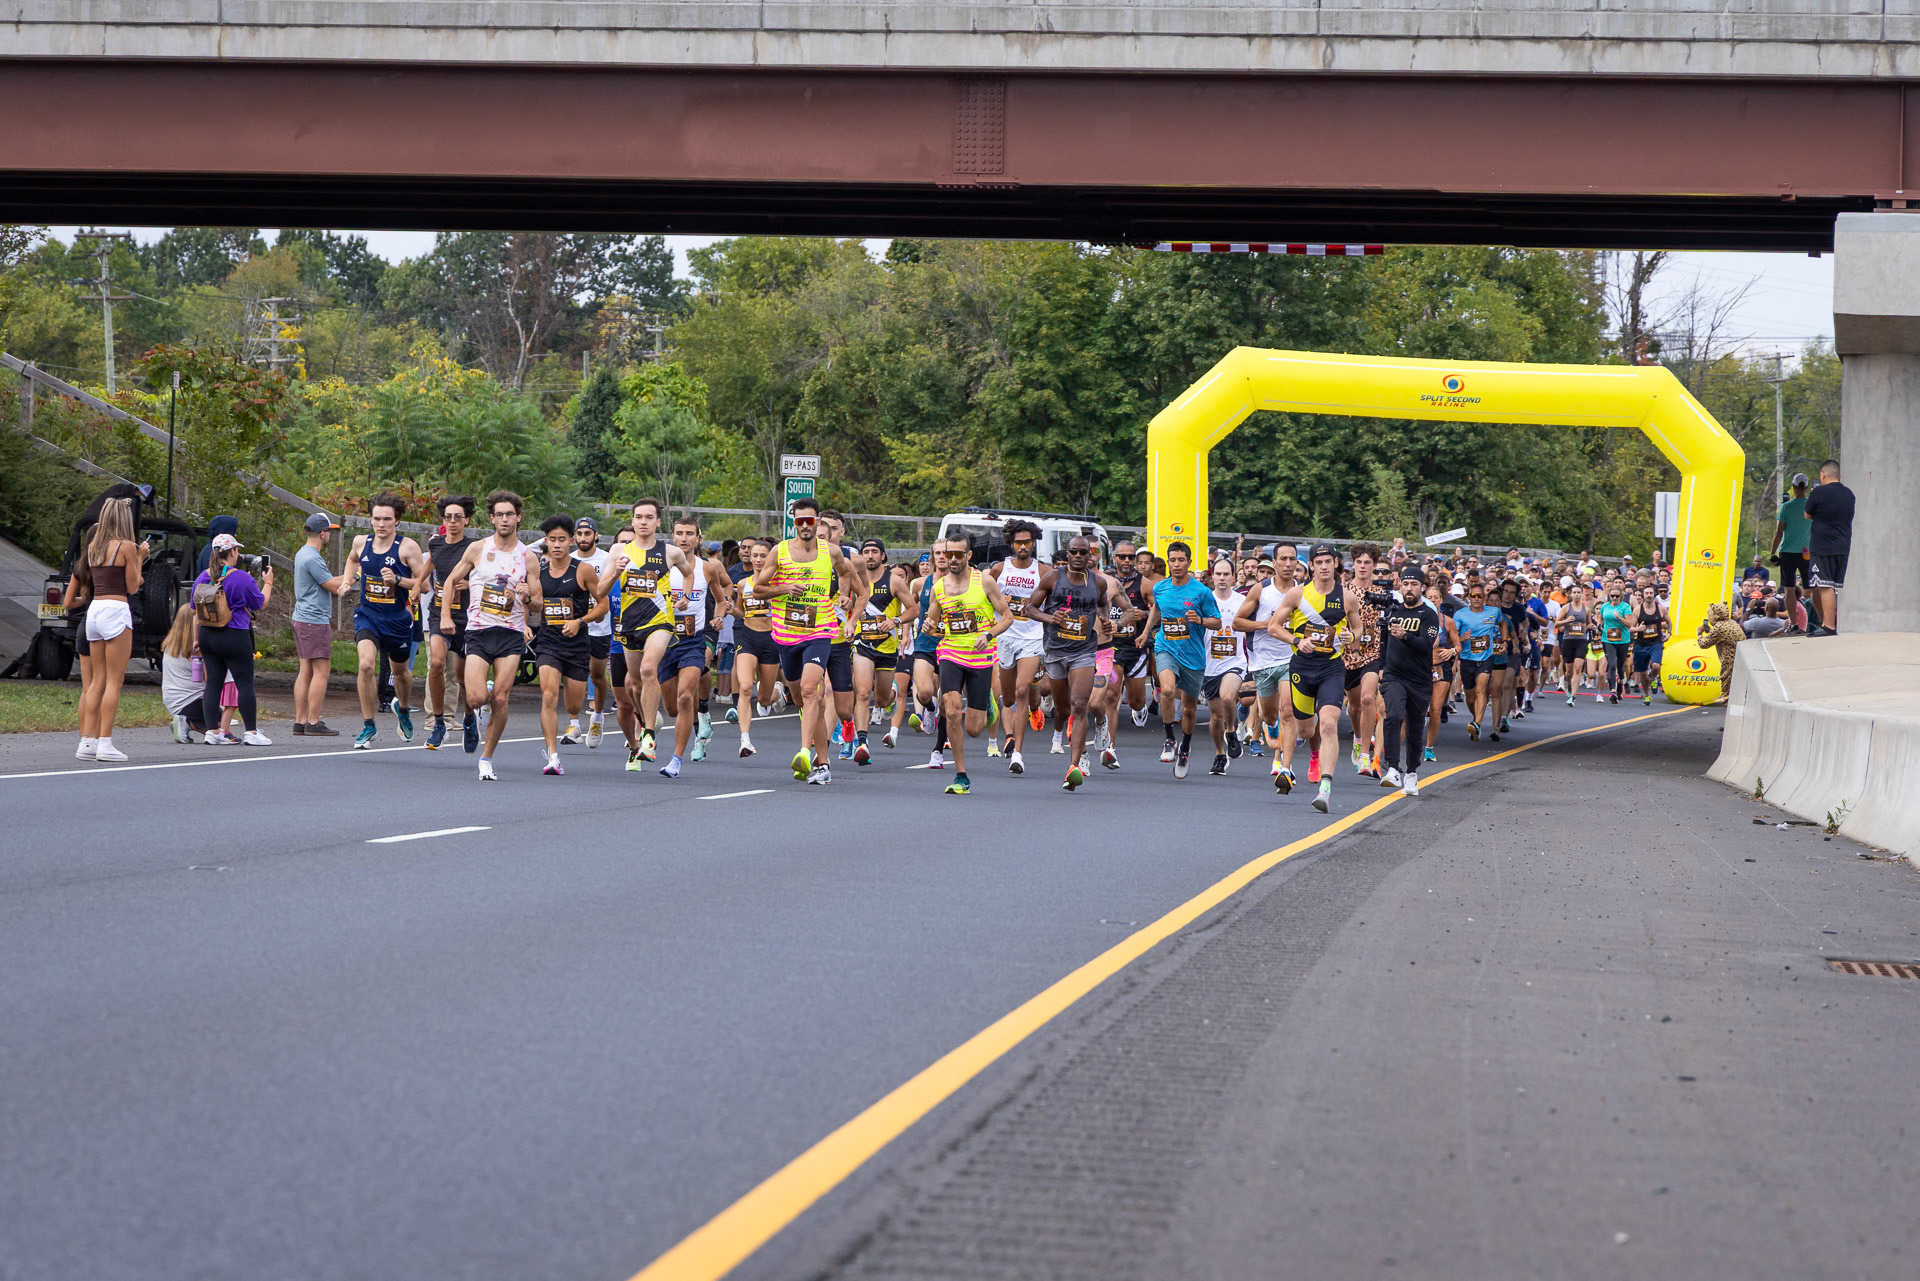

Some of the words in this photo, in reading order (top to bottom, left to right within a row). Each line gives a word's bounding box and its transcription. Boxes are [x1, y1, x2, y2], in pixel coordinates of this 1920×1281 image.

[1420, 394, 1444, 402] SPLIT
[1447, 396, 1481, 404] SECOND
[784, 460, 816, 471] BY-PASS
[788, 480, 812, 494] SOUTH
[628, 577, 655, 588] 205
[1006, 575, 1035, 586] LEONIA
[369, 584, 390, 594] 137
[488, 594, 508, 605] 39
[545, 607, 571, 615] 258
[791, 612, 810, 622] 94
[951, 620, 972, 630] 217
[1065, 621, 1082, 631] 75
[1163, 624, 1187, 632] 233
[1310, 632, 1329, 642] 97
[1213, 644, 1234, 652] 212
[1690, 675, 1720, 683] SECOND
